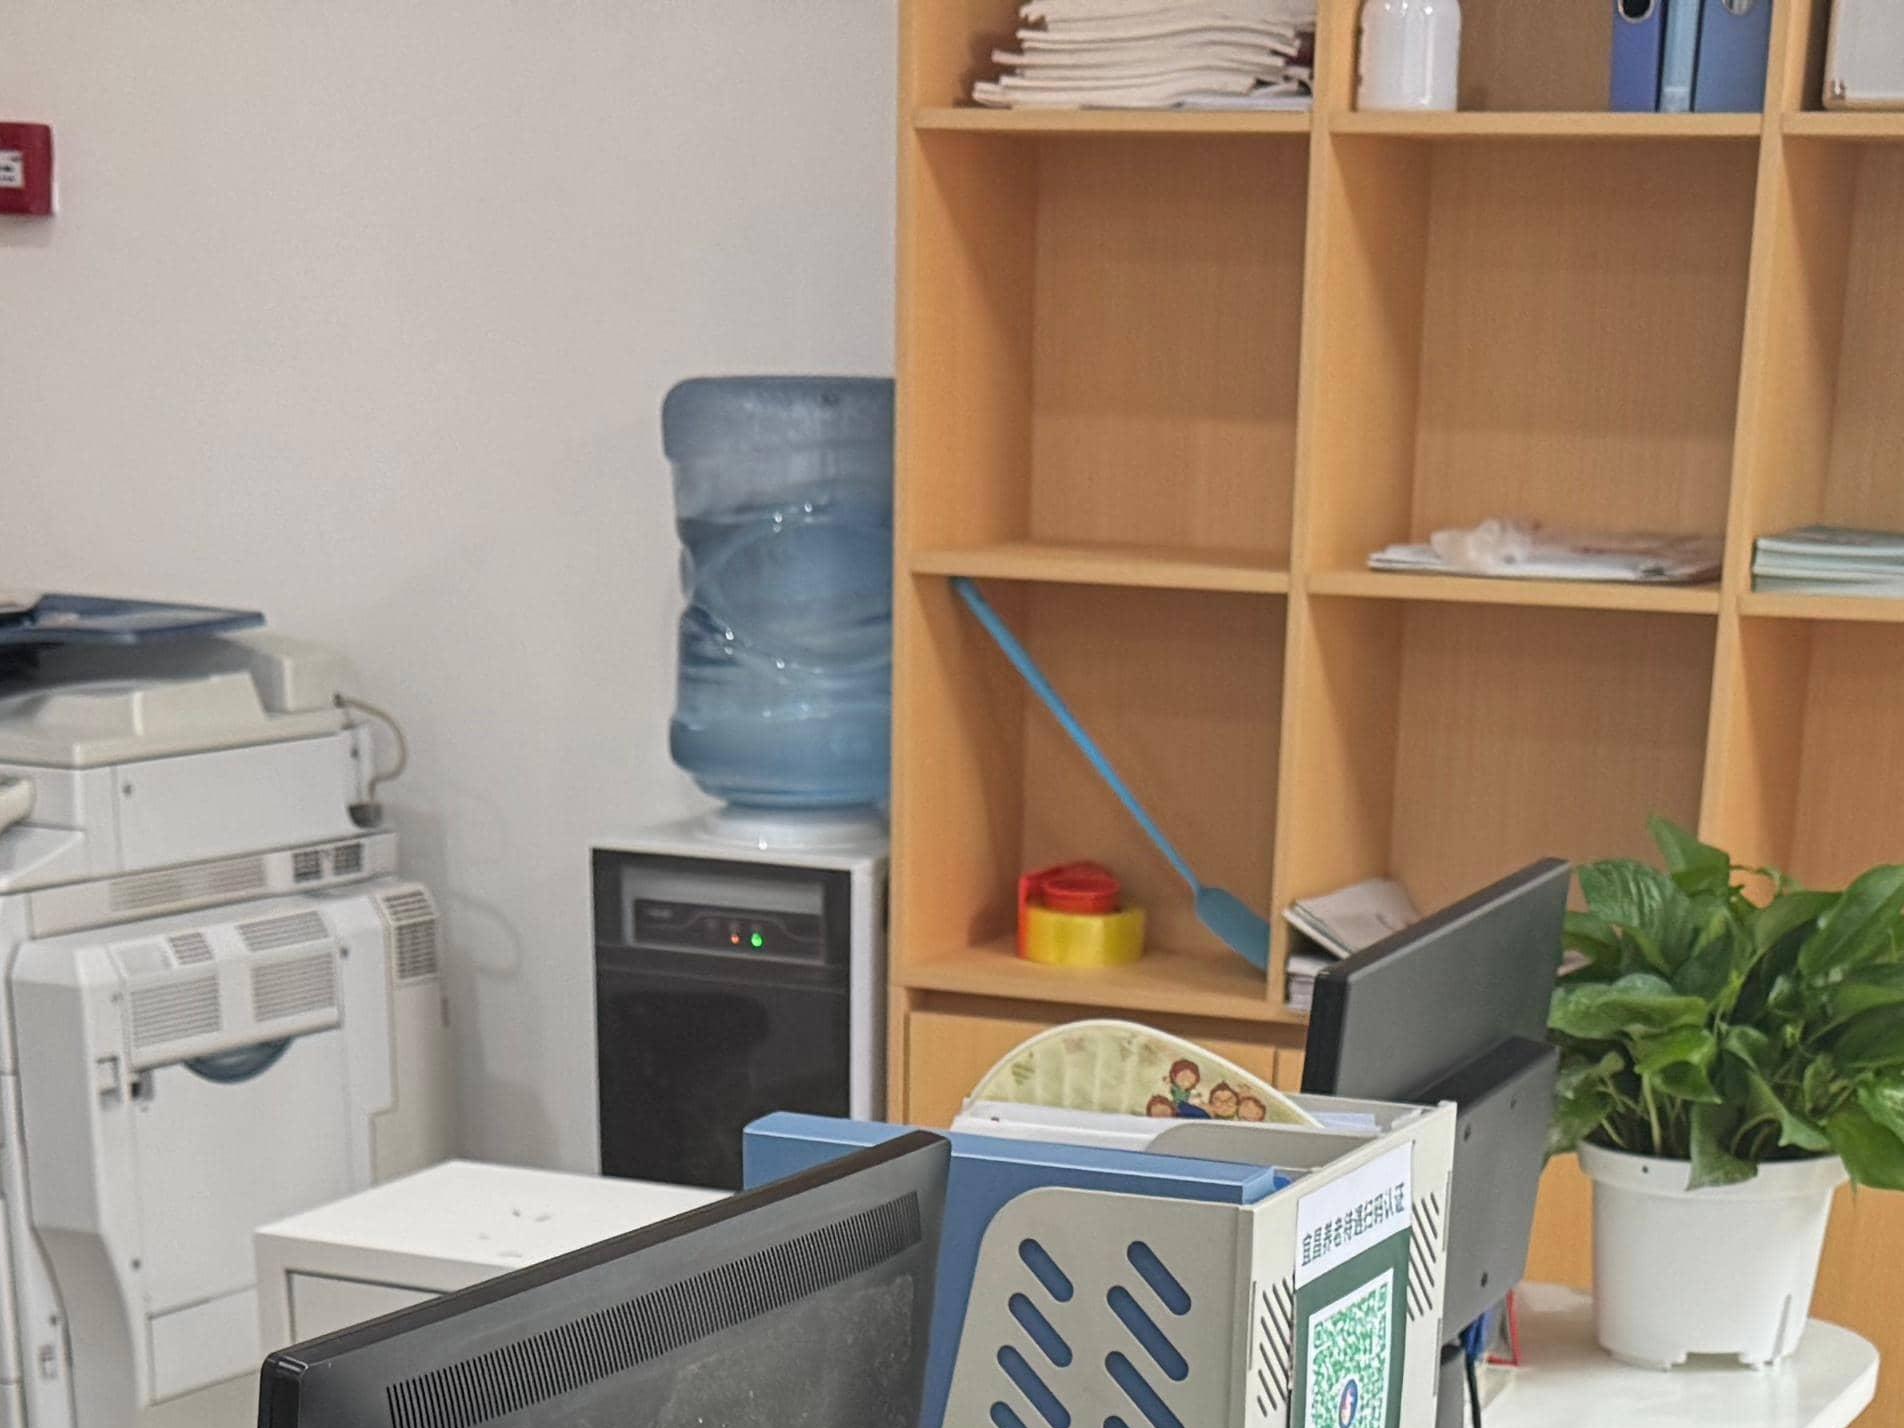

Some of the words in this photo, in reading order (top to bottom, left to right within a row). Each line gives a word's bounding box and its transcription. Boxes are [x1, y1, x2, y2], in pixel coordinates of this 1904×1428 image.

[1301, 1181, 1405, 1267] 宜昌养老待遇扫码认证
